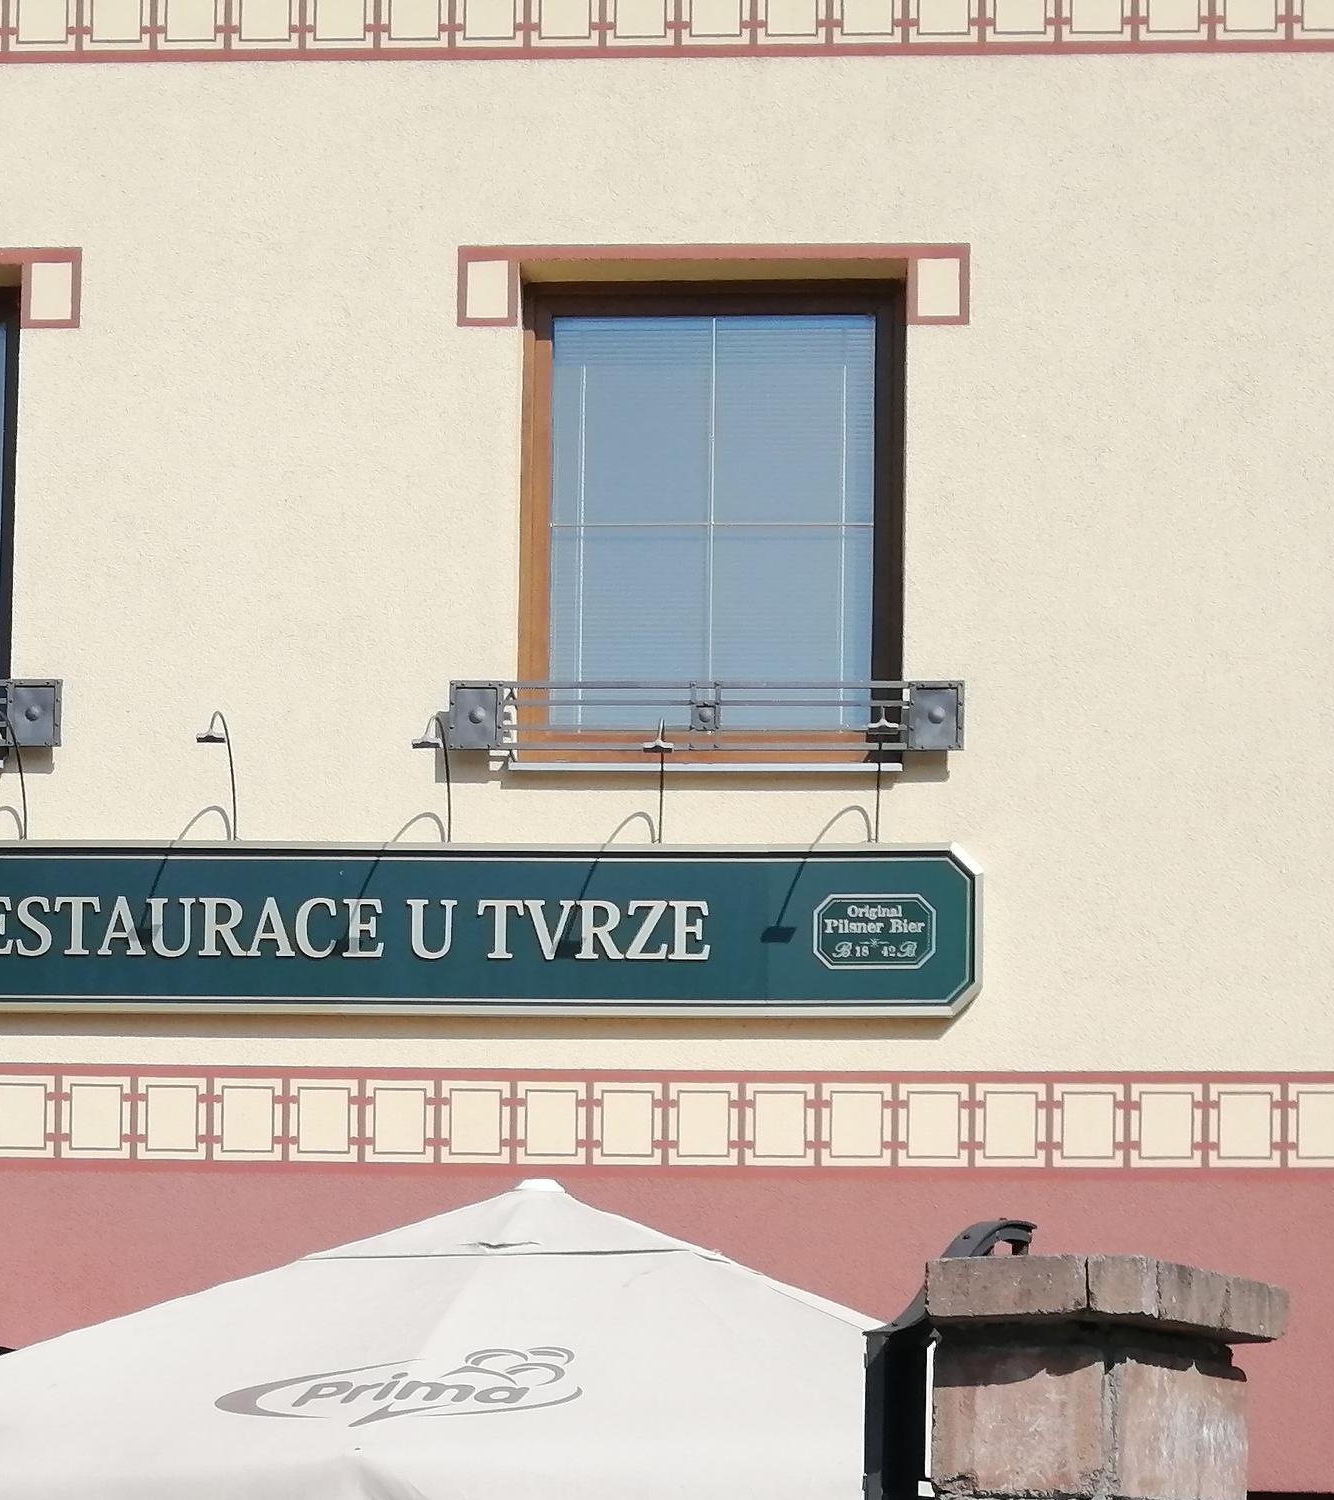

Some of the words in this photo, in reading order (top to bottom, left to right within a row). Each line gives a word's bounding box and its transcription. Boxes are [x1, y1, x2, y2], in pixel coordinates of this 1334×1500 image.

[846, 904, 903, 920] Original
[406, 898, 460, 961] U
[476, 898, 711, 961] TVRZE
[823, 918, 885, 934] Pilsner
[888, 918, 926, 934] Bier
[293, 1371, 530, 1409] Prima
